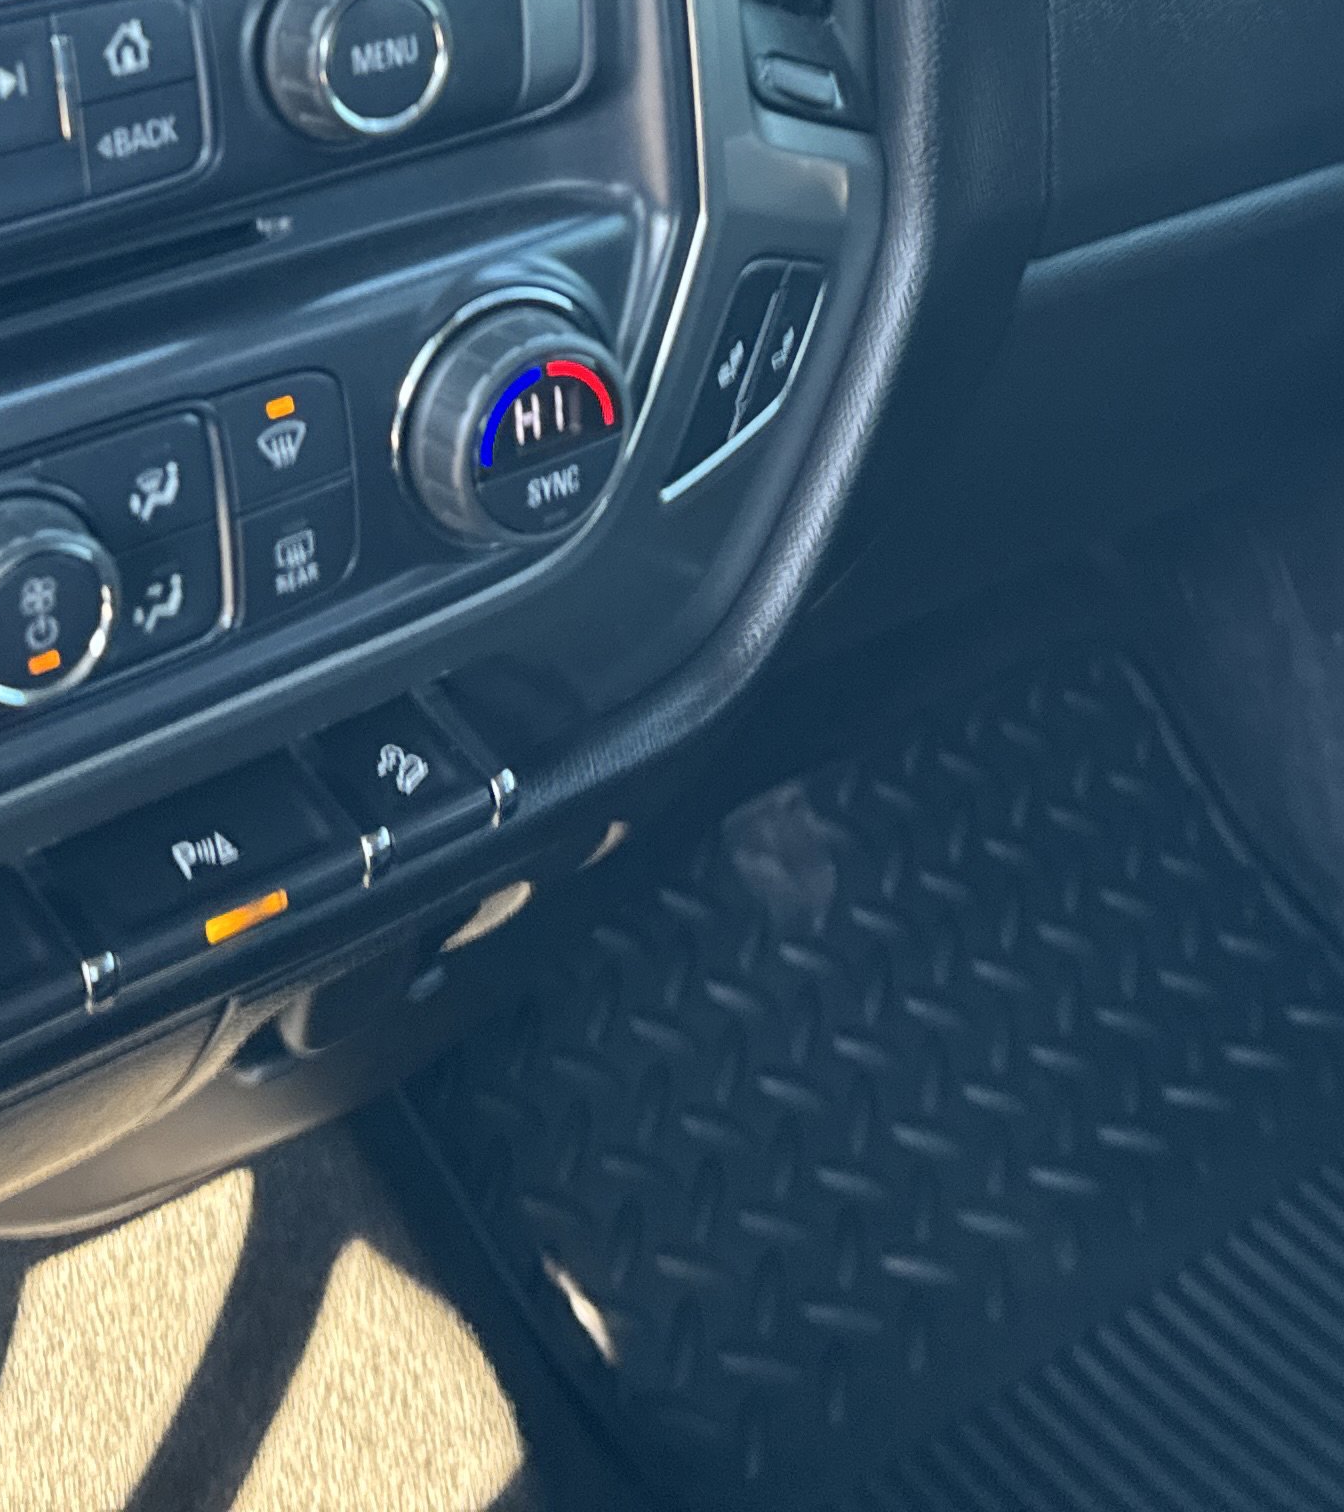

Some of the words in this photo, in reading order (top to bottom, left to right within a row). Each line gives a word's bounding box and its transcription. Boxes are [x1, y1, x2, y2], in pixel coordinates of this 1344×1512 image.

[351, 35, 419, 74] MENU
[114, 117, 177, 159] BACK
[527, 465, 581, 508] SYNC
